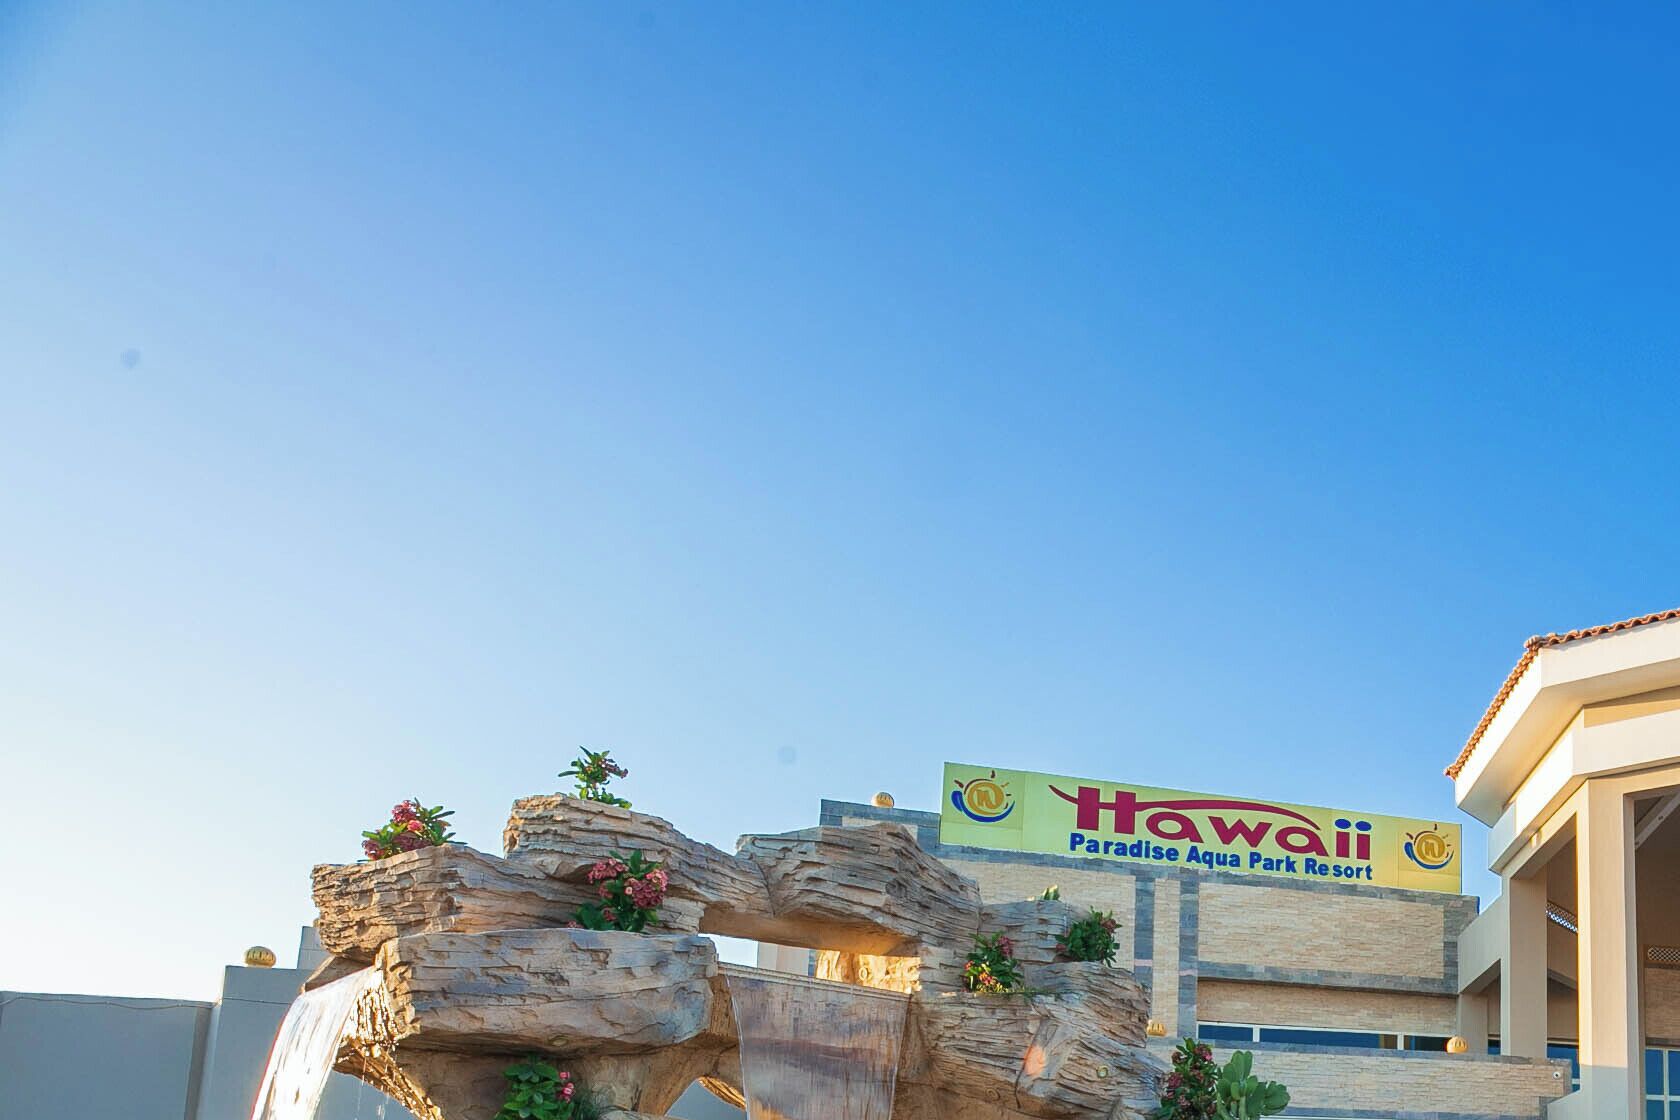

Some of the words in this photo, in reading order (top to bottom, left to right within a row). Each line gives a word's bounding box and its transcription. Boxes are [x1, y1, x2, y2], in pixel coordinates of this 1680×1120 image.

[1048, 785, 1373, 861] Hawaii
[1069, 832, 1179, 862] Paradise
[1186, 845, 1241, 869] Aqua
[1249, 851, 1297, 873] Park
[1304, 857, 1373, 881] Resort
